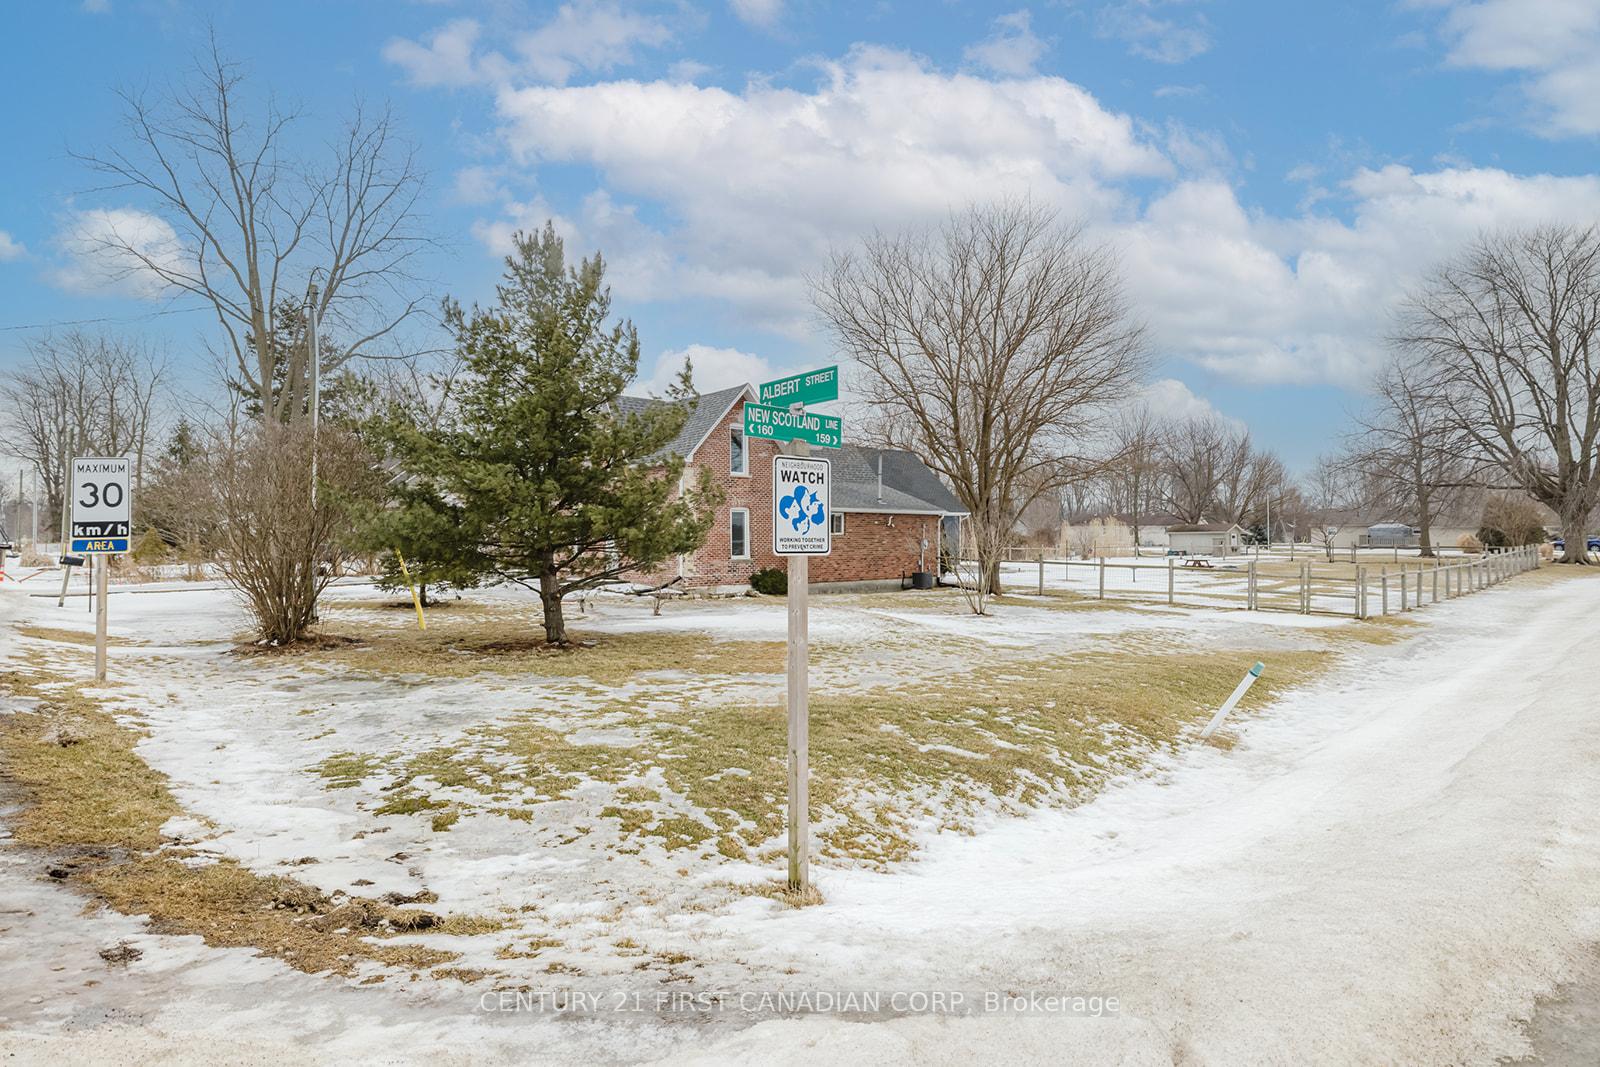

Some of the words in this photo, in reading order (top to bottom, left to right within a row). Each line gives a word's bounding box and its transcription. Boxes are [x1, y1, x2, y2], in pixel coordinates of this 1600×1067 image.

[762, 378, 801, 400] ALBERT
[805, 370, 835, 386] STREET
[748, 407, 770, 423] NEW
[772, 411, 820, 431] SCOTLAND
[825, 419, 839, 430] LINE
[757, 425, 774, 436] 160
[816, 433, 831, 444] 159
[77, 464, 125, 473] MAXIMUM
[781, 462, 824, 471] NEIGHBOURHOOD
[780, 470, 825, 484] WATCH
[79, 482, 123, 508] 30
[73, 523, 128, 536] km/h
[85, 541, 115, 551] AREA
